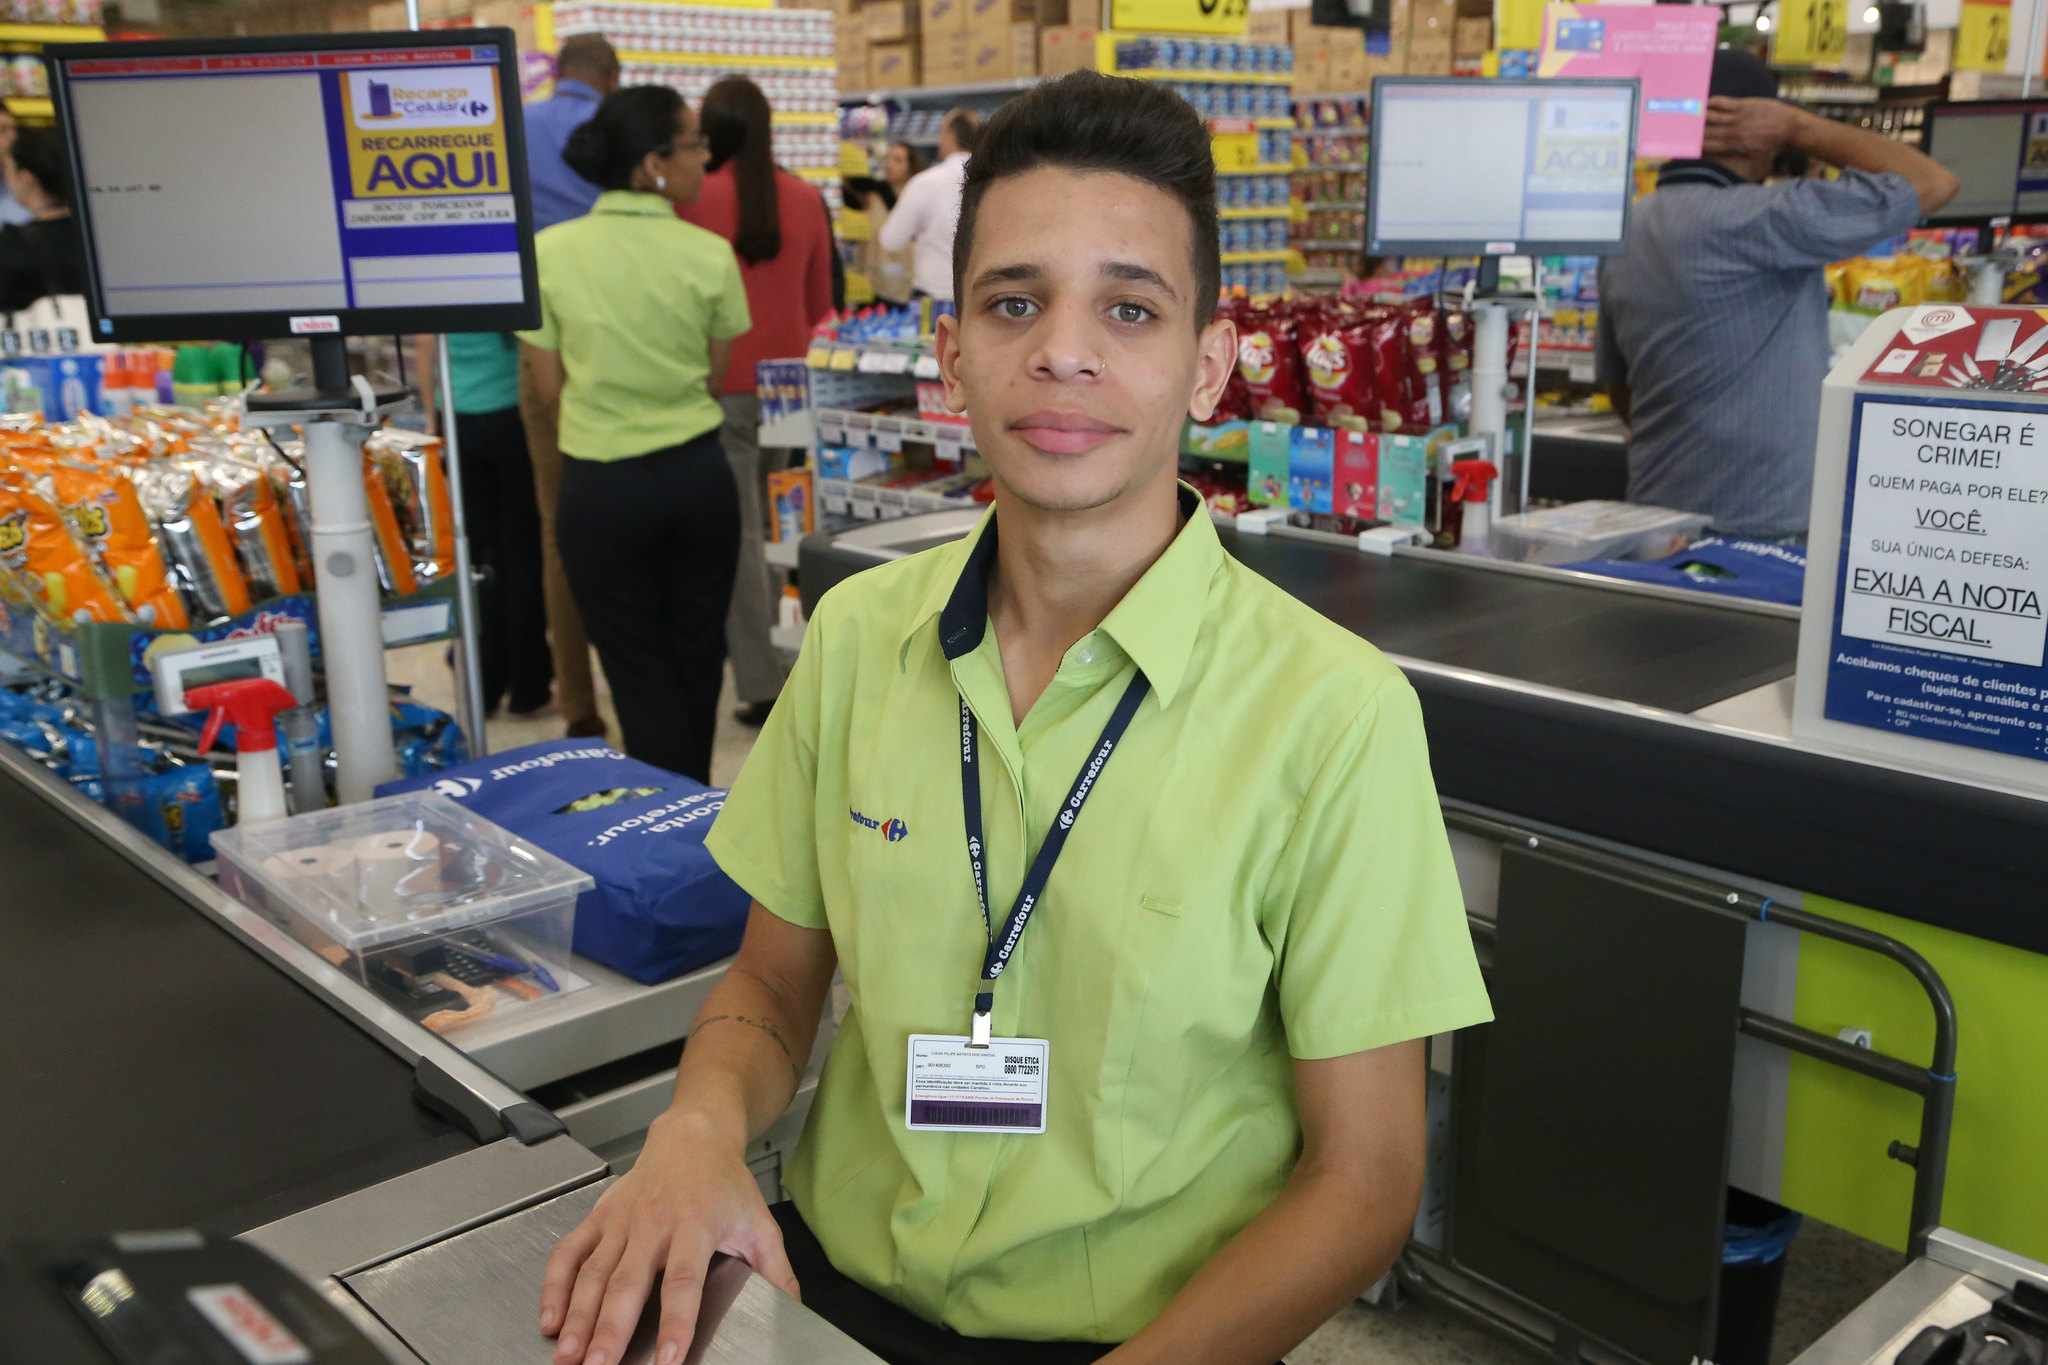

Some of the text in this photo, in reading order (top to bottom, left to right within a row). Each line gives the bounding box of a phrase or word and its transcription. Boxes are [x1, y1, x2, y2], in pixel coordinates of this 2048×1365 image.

[392, 88, 468, 102] Recarga
[402, 101, 458, 113] Celular
[361, 133, 494, 151] RECARREGUE
[367, 151, 498, 192] AQUI
[1544, 149, 1620, 170] AQUI
[1892, 417, 2036, 446] SONEGAR É
[1917, 444, 2001, 469] CRIME!
[1869, 474, 2048, 504] QUEM PAGA POR ELE?
[1916, 507, 1987, 534] VOCÊ.
[1871, 539, 2029, 571] SUA ÚNICA DEFESA:
[1853, 567, 2042, 616] EXIJA A NOTA
[1888, 607, 1992, 645] FISCAL.
[1836, 652, 1902, 674] Aceitamos
[1904, 663, 1959, 684] cheques
[1962, 674, 1979, 688] de
[1982, 679, 2037, 697] clientes
[1866, 690, 1891, 704] Para
[1893, 696, 1965, 719] cadastrar-se,
[1967, 711, 2026, 728] apresente
[2028, 721, 2043, 731] os
[1921, 682, 1972, 700] (sujeitos
[1974, 693, 1982, 702] a
[1985, 694, 2029, 710] análise
[2032, 703, 2041, 712] e
[1894, 718, 1911, 728] CPF
[1953, 720, 2001, 736] Profissional
[490, 747, 626, 781] Carrefour
[1070, 739, 1113, 808] Carrefour
[587, 790, 727, 847] Carrefour.
[998, 894, 1035, 960] Carrefour
[1004, 1056, 1024, 1064] DISQUE
[1004, 1064, 1017, 1074] 0800
